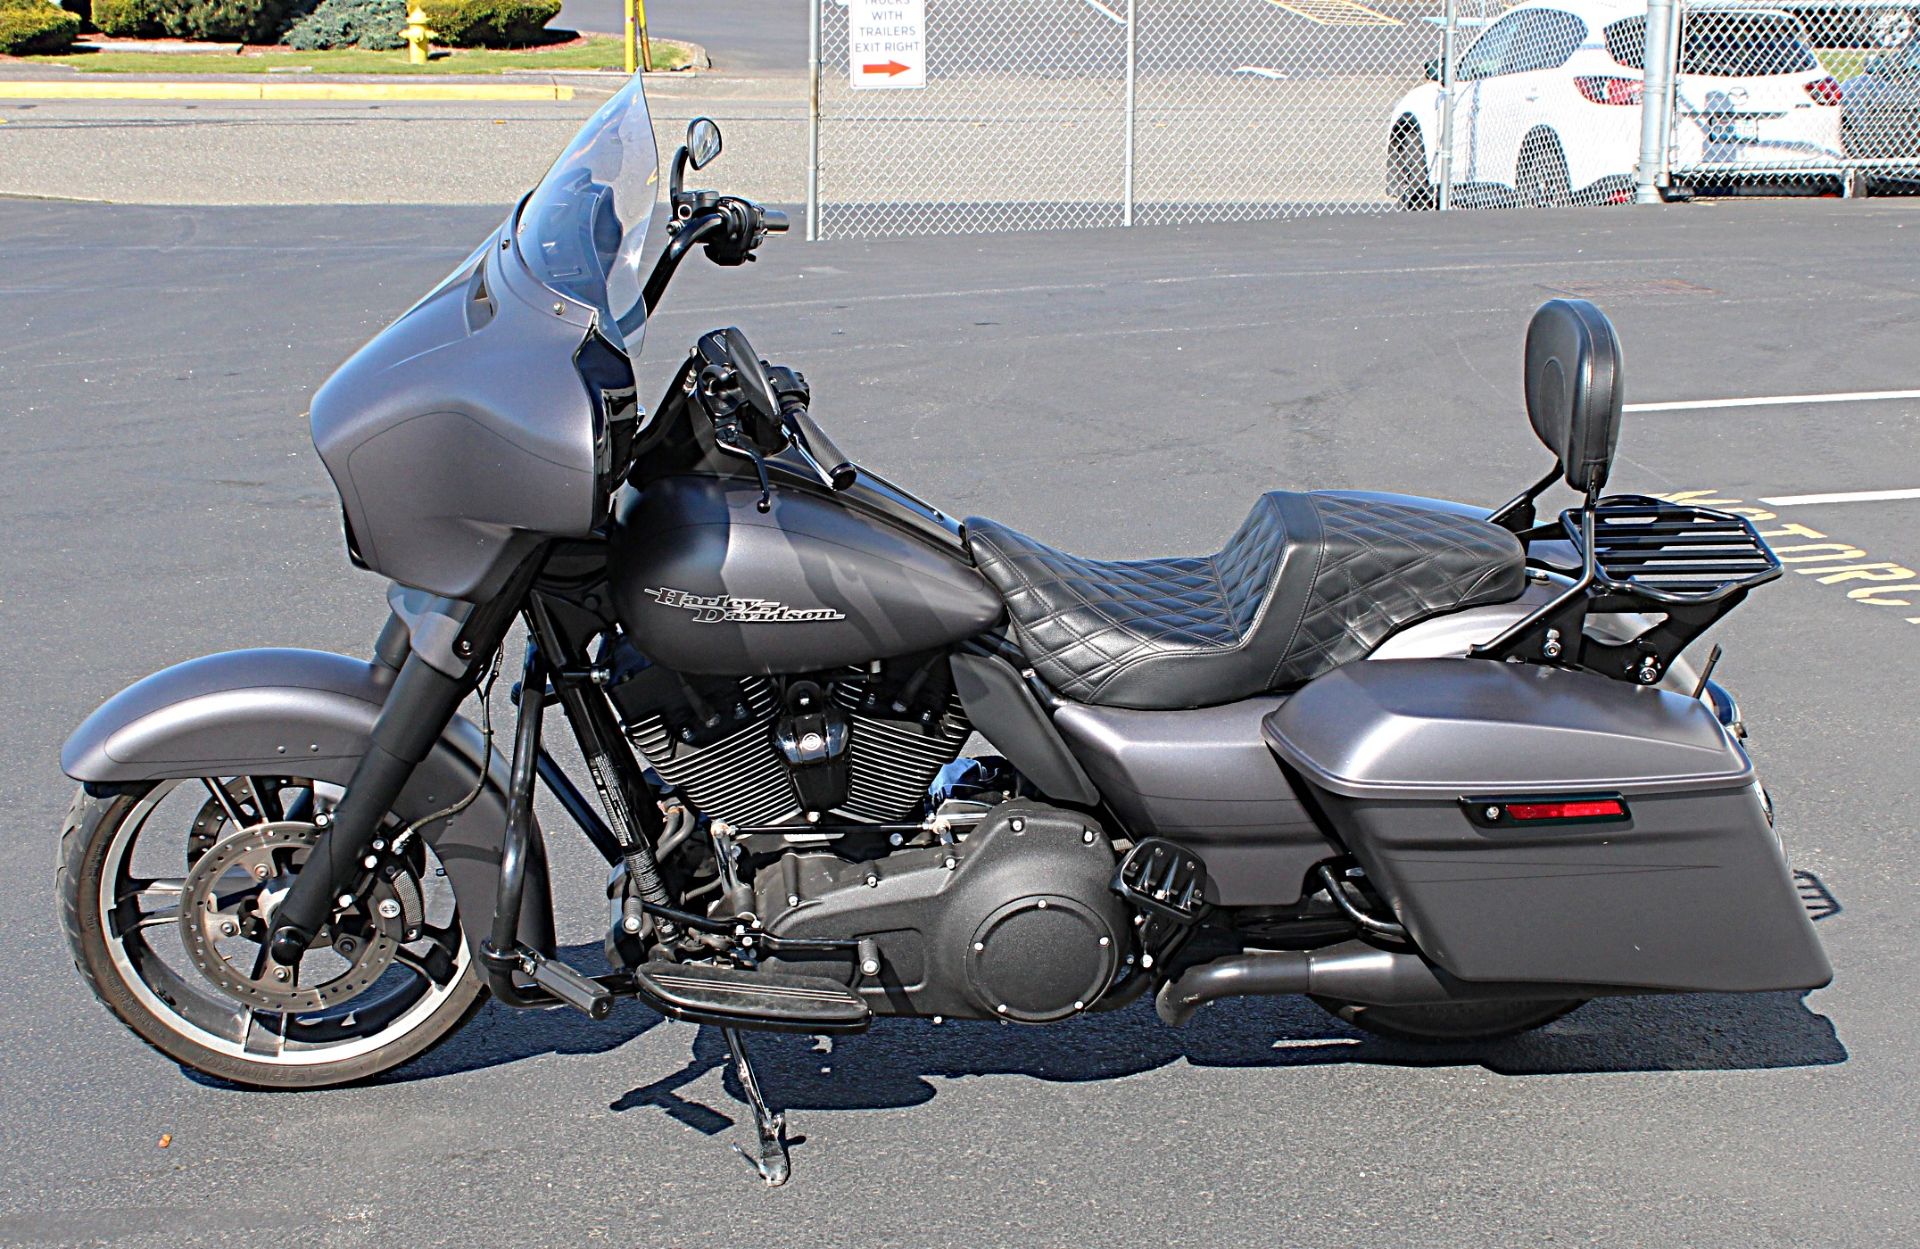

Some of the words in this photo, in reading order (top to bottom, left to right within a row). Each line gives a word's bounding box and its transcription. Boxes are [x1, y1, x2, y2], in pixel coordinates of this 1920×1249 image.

[871, 11, 903, 20] WITH
[859, 26, 917, 37] TRAILERS
[855, 42, 881, 53] EXIT
[885, 41, 921, 53] RIGHT
